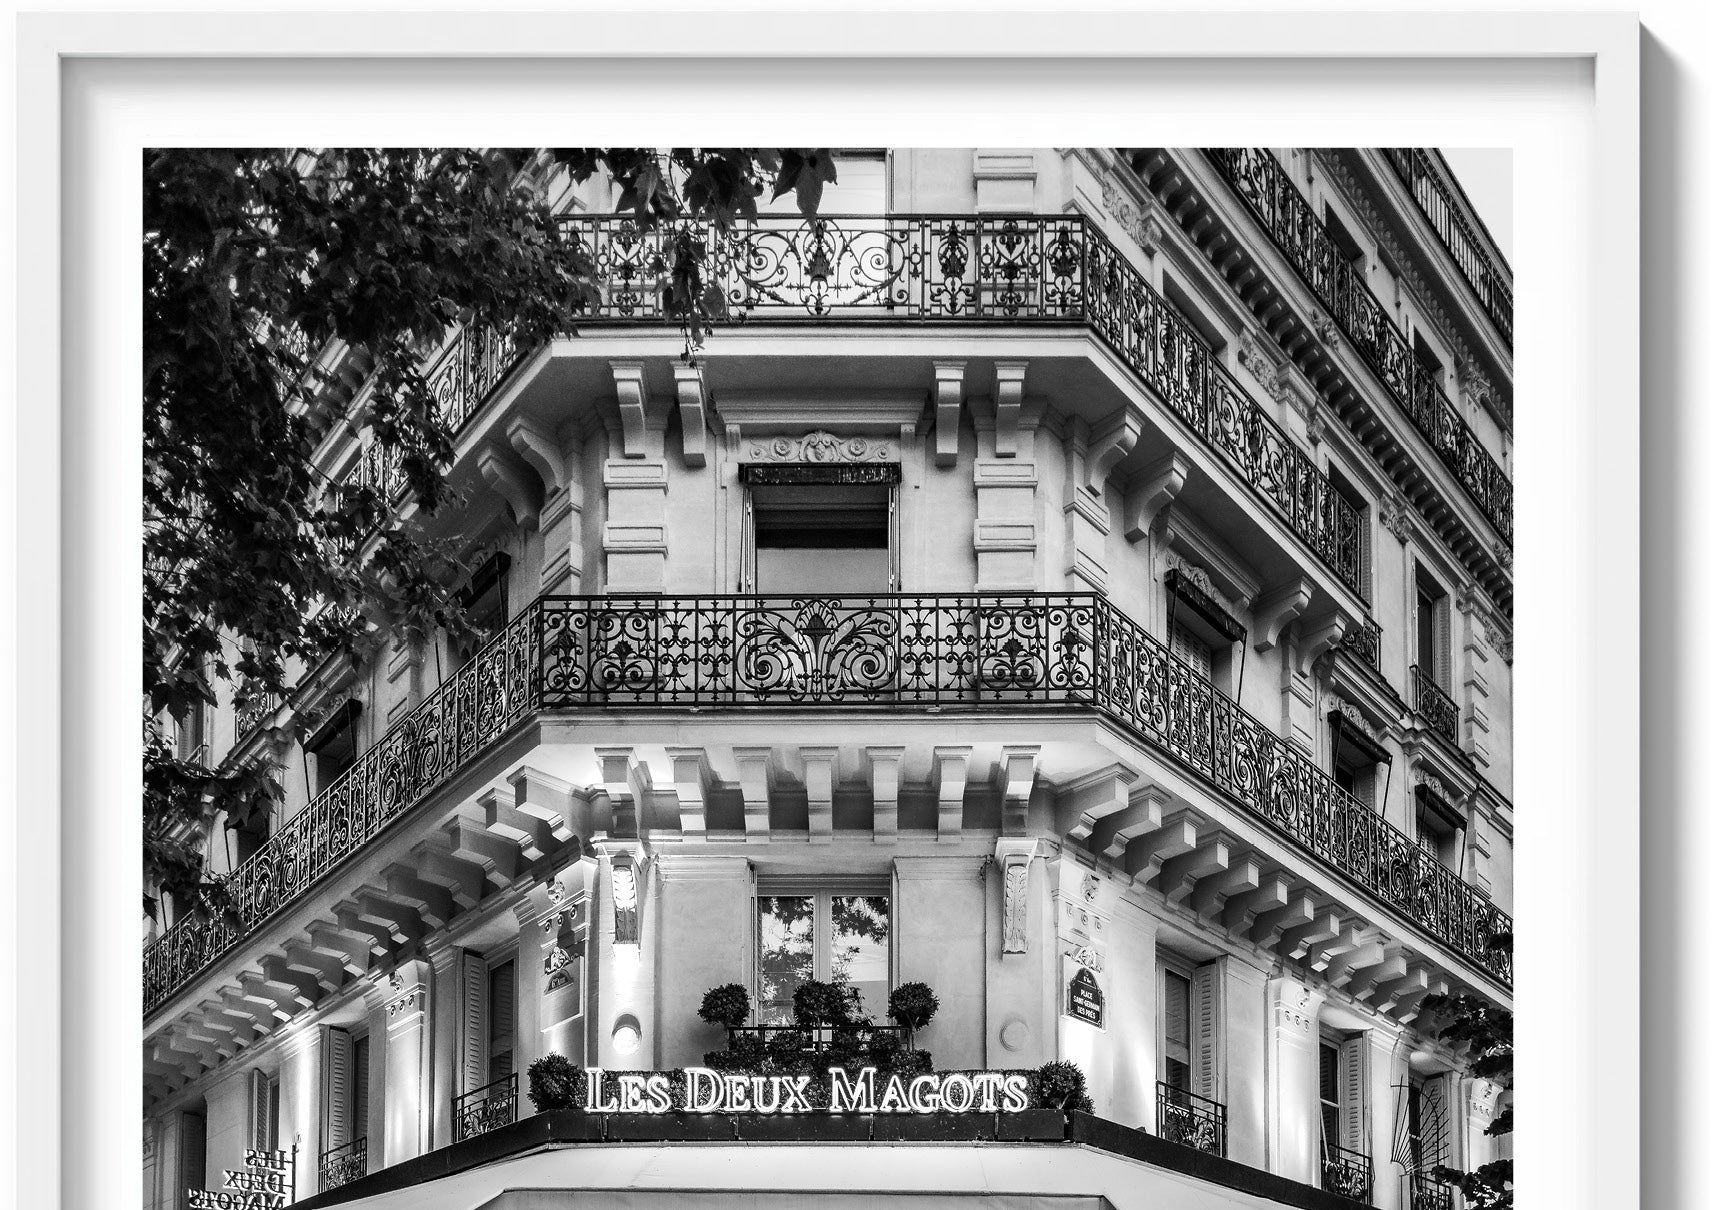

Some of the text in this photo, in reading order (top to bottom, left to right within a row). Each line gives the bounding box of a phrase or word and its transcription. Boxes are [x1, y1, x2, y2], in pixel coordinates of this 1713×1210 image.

[584, 1066, 1029, 1114] LES DEUX MAGOTS
